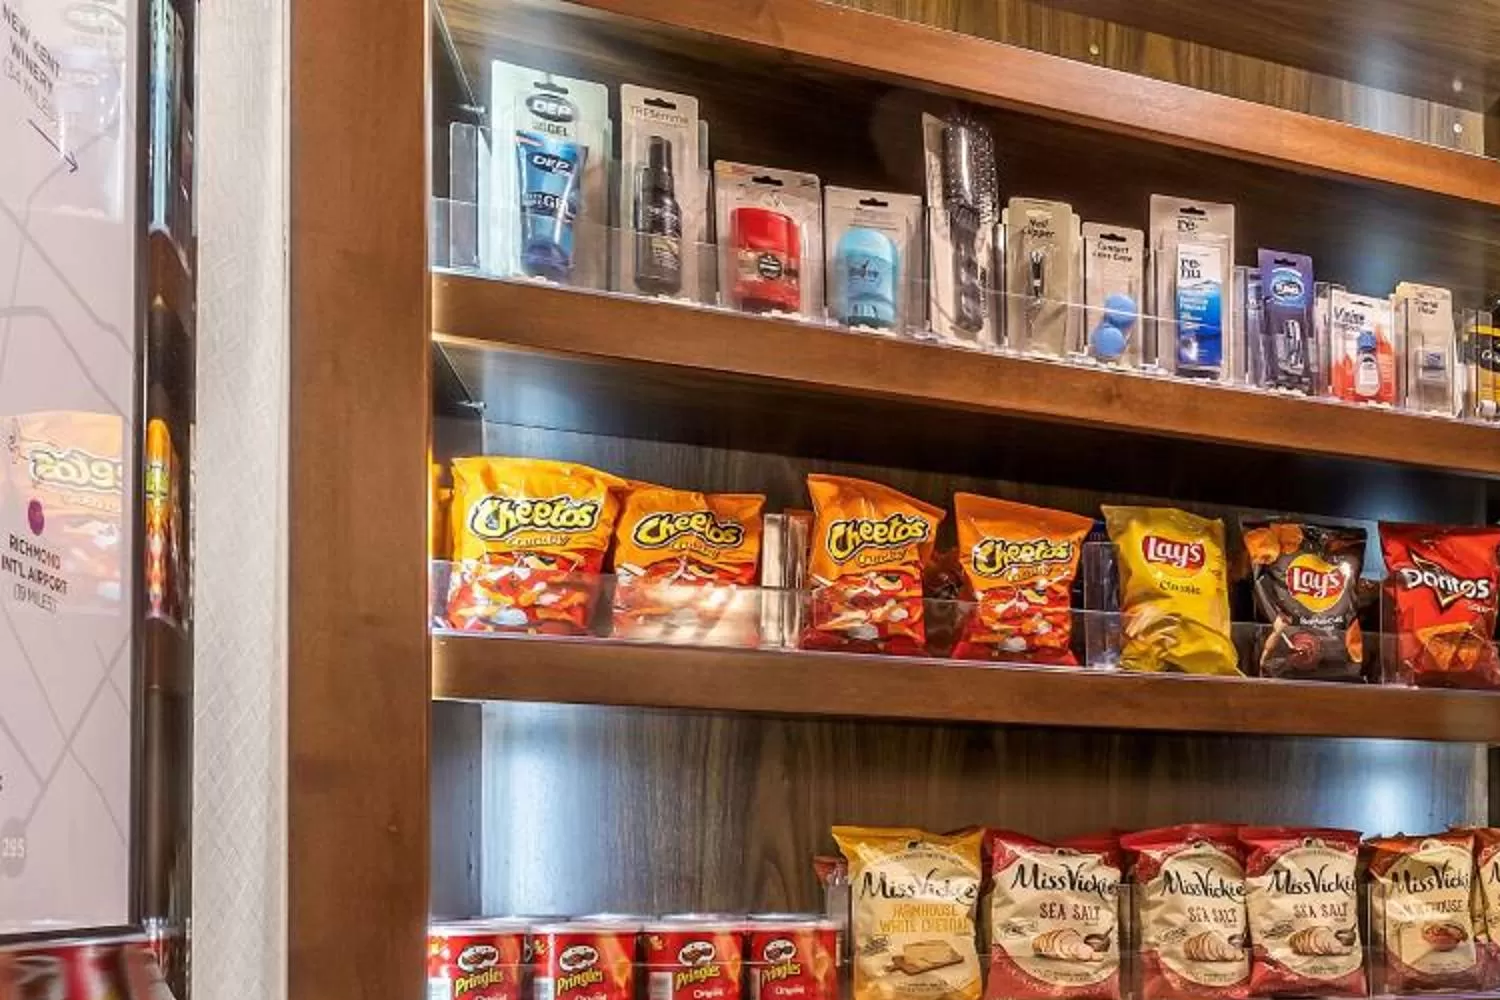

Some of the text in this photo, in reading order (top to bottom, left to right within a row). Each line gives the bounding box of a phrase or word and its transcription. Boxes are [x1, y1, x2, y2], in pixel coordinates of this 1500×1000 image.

[532, 100, 573, 116] DEP
[532, 153, 571, 170] DEP
[473, 497, 597, 537] Cheetos
[635, 513, 742, 547] Cheetos
[9, 533, 61, 570] RICHMOND
[828, 514, 929, 563] Cheetos
[974, 538, 1073, 574] Cheetos
[28, 569, 68, 595] AIRPORT
[1401, 566, 1490, 599] Doritos
[862, 869, 915, 900] Miss
[1011, 863, 1066, 890] Miss
[1160, 870, 1201, 896] Miss
[1266, 869, 1309, 895] Miss
[1391, 870, 1435, 895] Miss
[1039, 902, 1101, 921] SEA SALT
[1187, 906, 1238, 923] SEA SALT
[1293, 902, 1349, 920] SEA SALT
[456, 968, 504, 998] Pringles
[557, 968, 603, 996] Pringles
[675, 963, 721, 992] Pringles
[761, 961, 801, 988] Pringles
